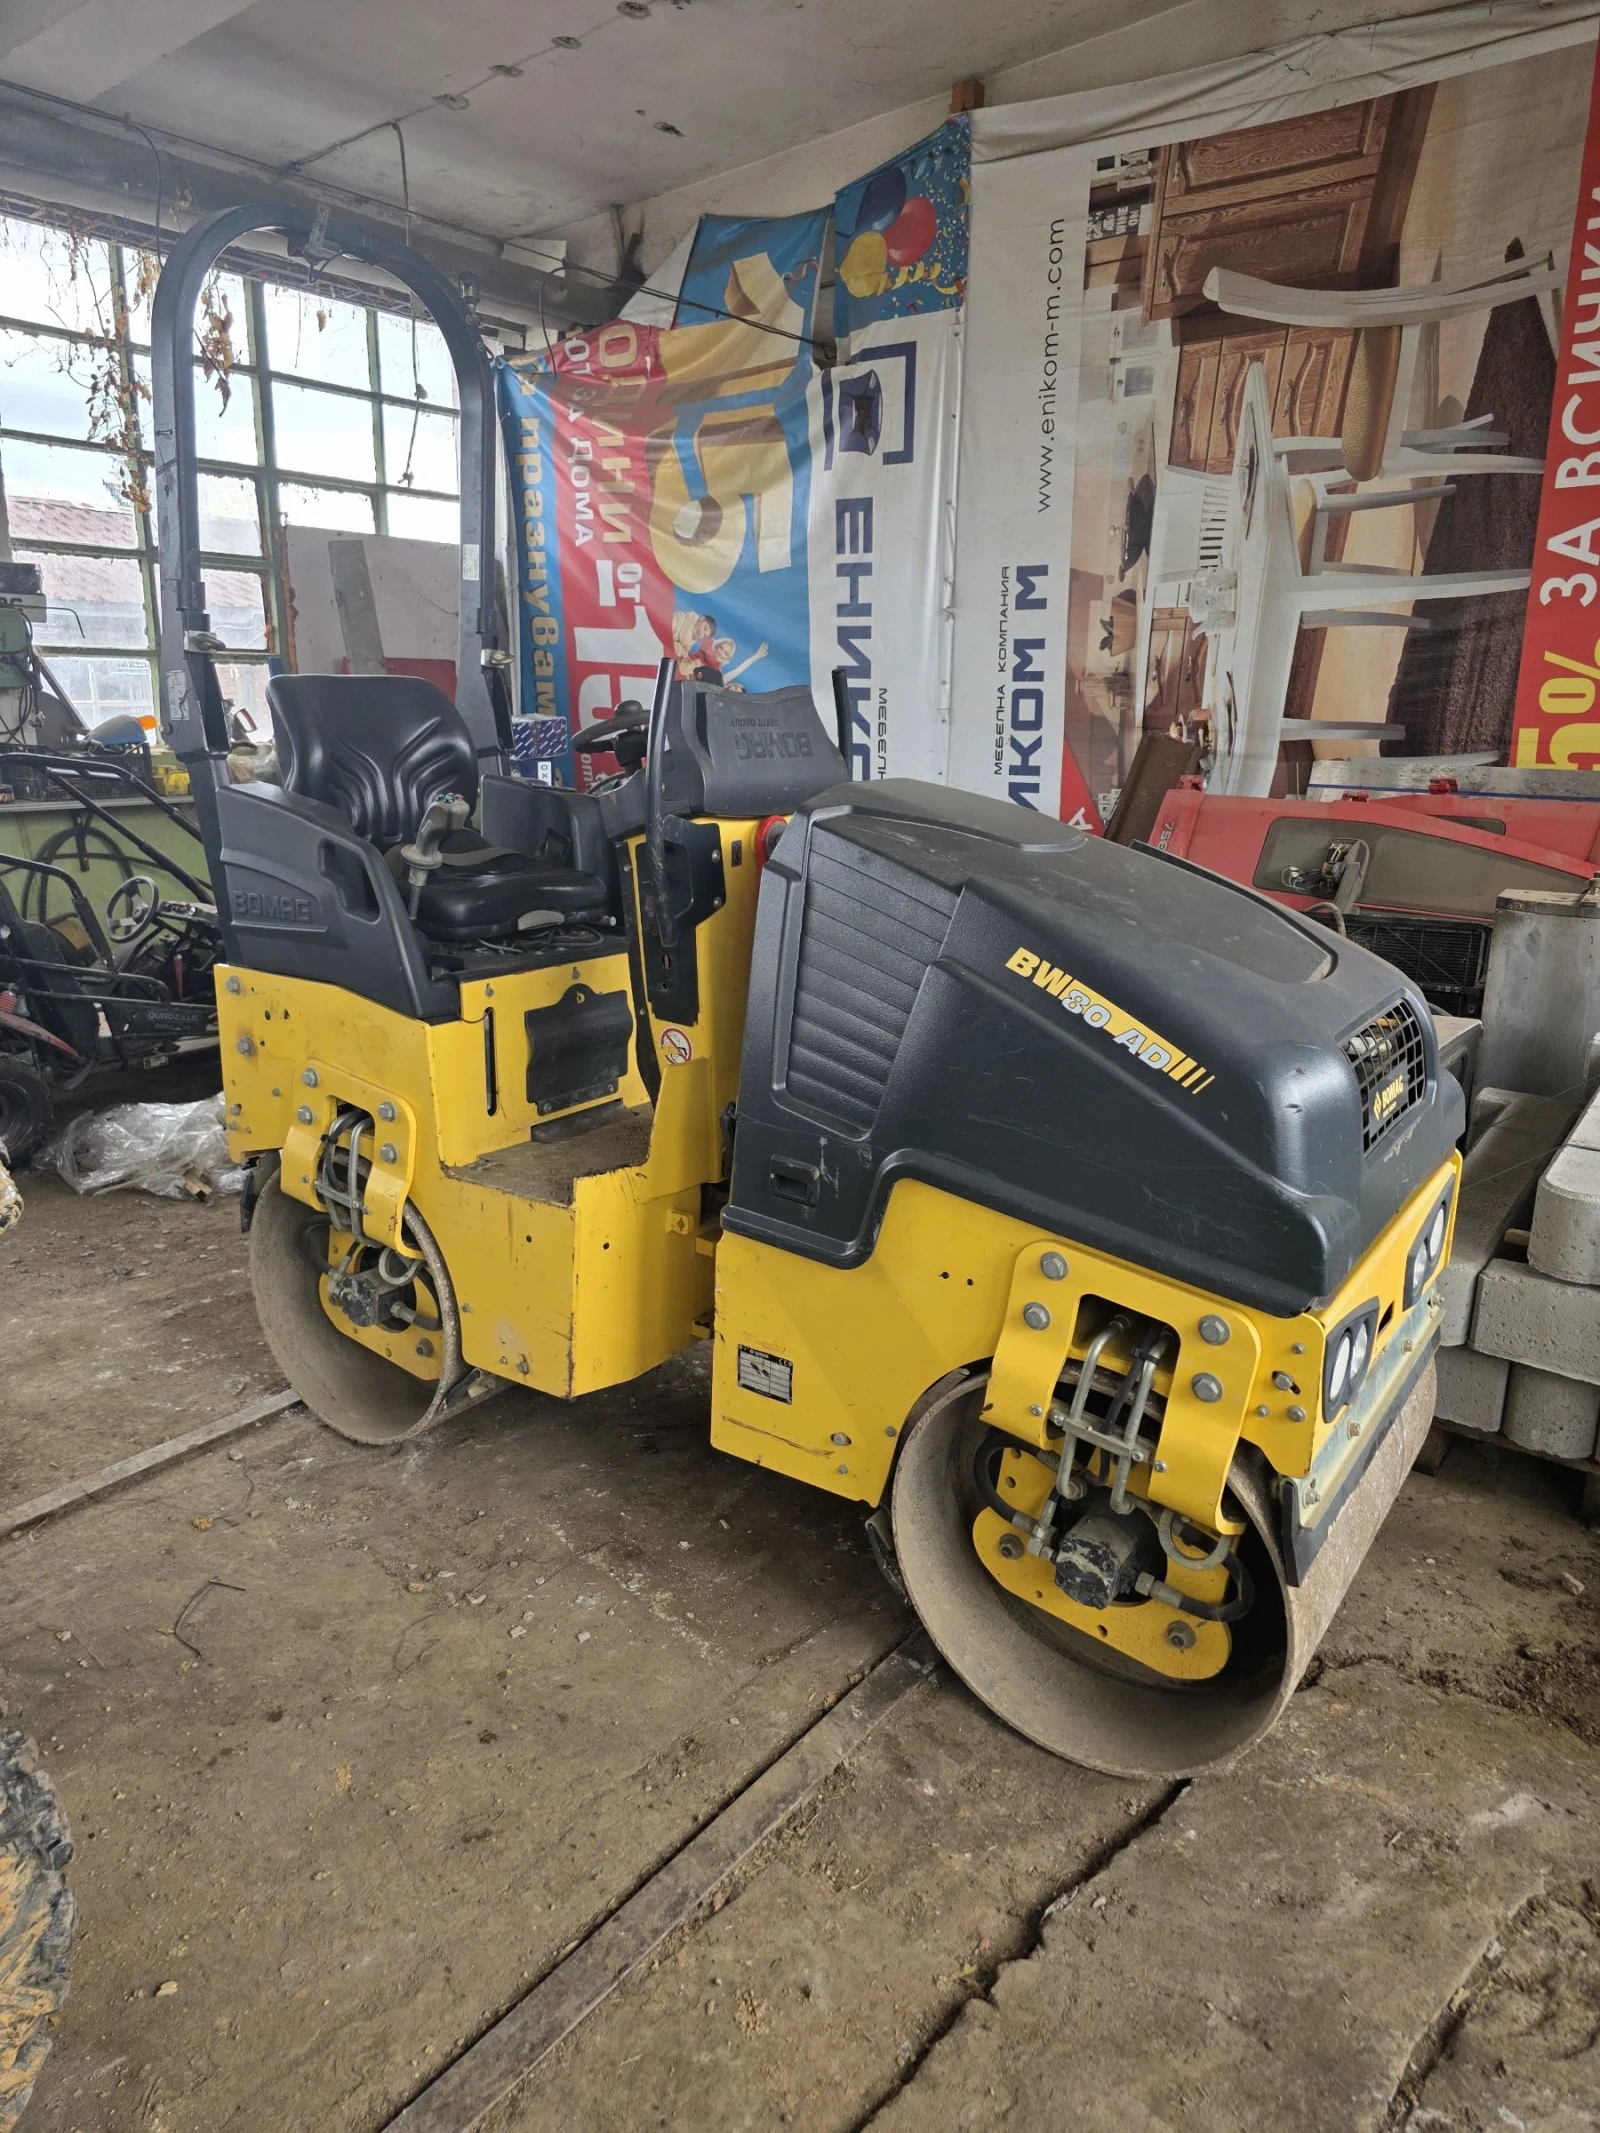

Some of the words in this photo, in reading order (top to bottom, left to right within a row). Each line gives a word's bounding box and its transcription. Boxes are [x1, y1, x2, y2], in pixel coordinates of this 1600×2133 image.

[1038, 217, 1065, 513] www.enikom-m.com
[566, 437, 596, 547] ДОМА
[1014, 564, 1049, 610] М
[1538, 520, 1600, 608] ЗА
[997, 566, 1010, 673] КОМПАНИЯ
[732, 731, 814, 760] BOMAG
[994, 684, 1006, 776] МЕБЕЛНА
[1008, 638, 1046, 811] ИКОМ
[232, 889, 312, 924] BOMAG
[1113, 1028, 1172, 1071] AD
